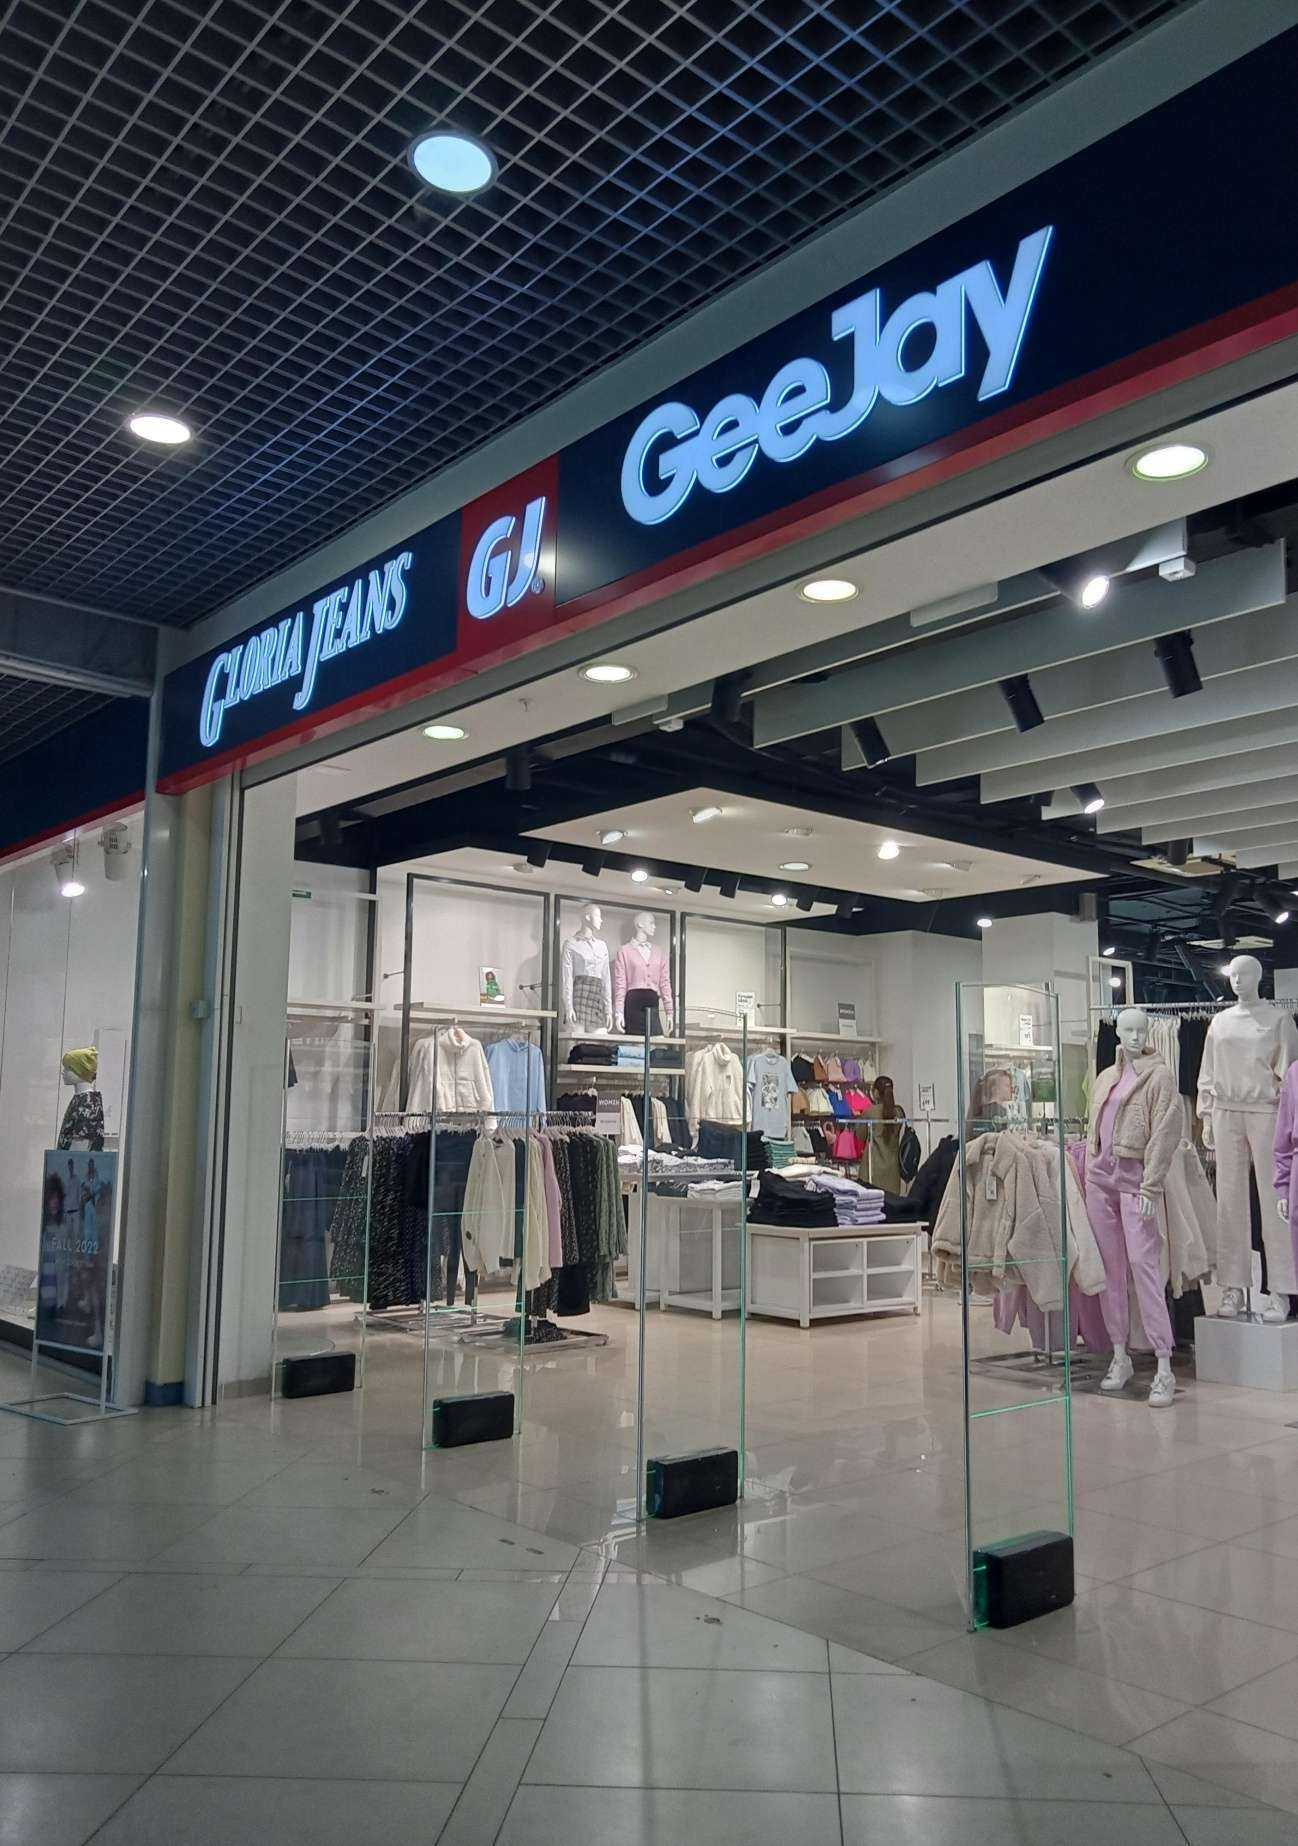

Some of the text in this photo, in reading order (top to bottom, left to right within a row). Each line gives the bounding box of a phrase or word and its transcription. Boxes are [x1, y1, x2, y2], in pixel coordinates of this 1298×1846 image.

[621, 225, 1054, 525] GeeJay
[200, 551, 413, 748] GLORIA JEANS
